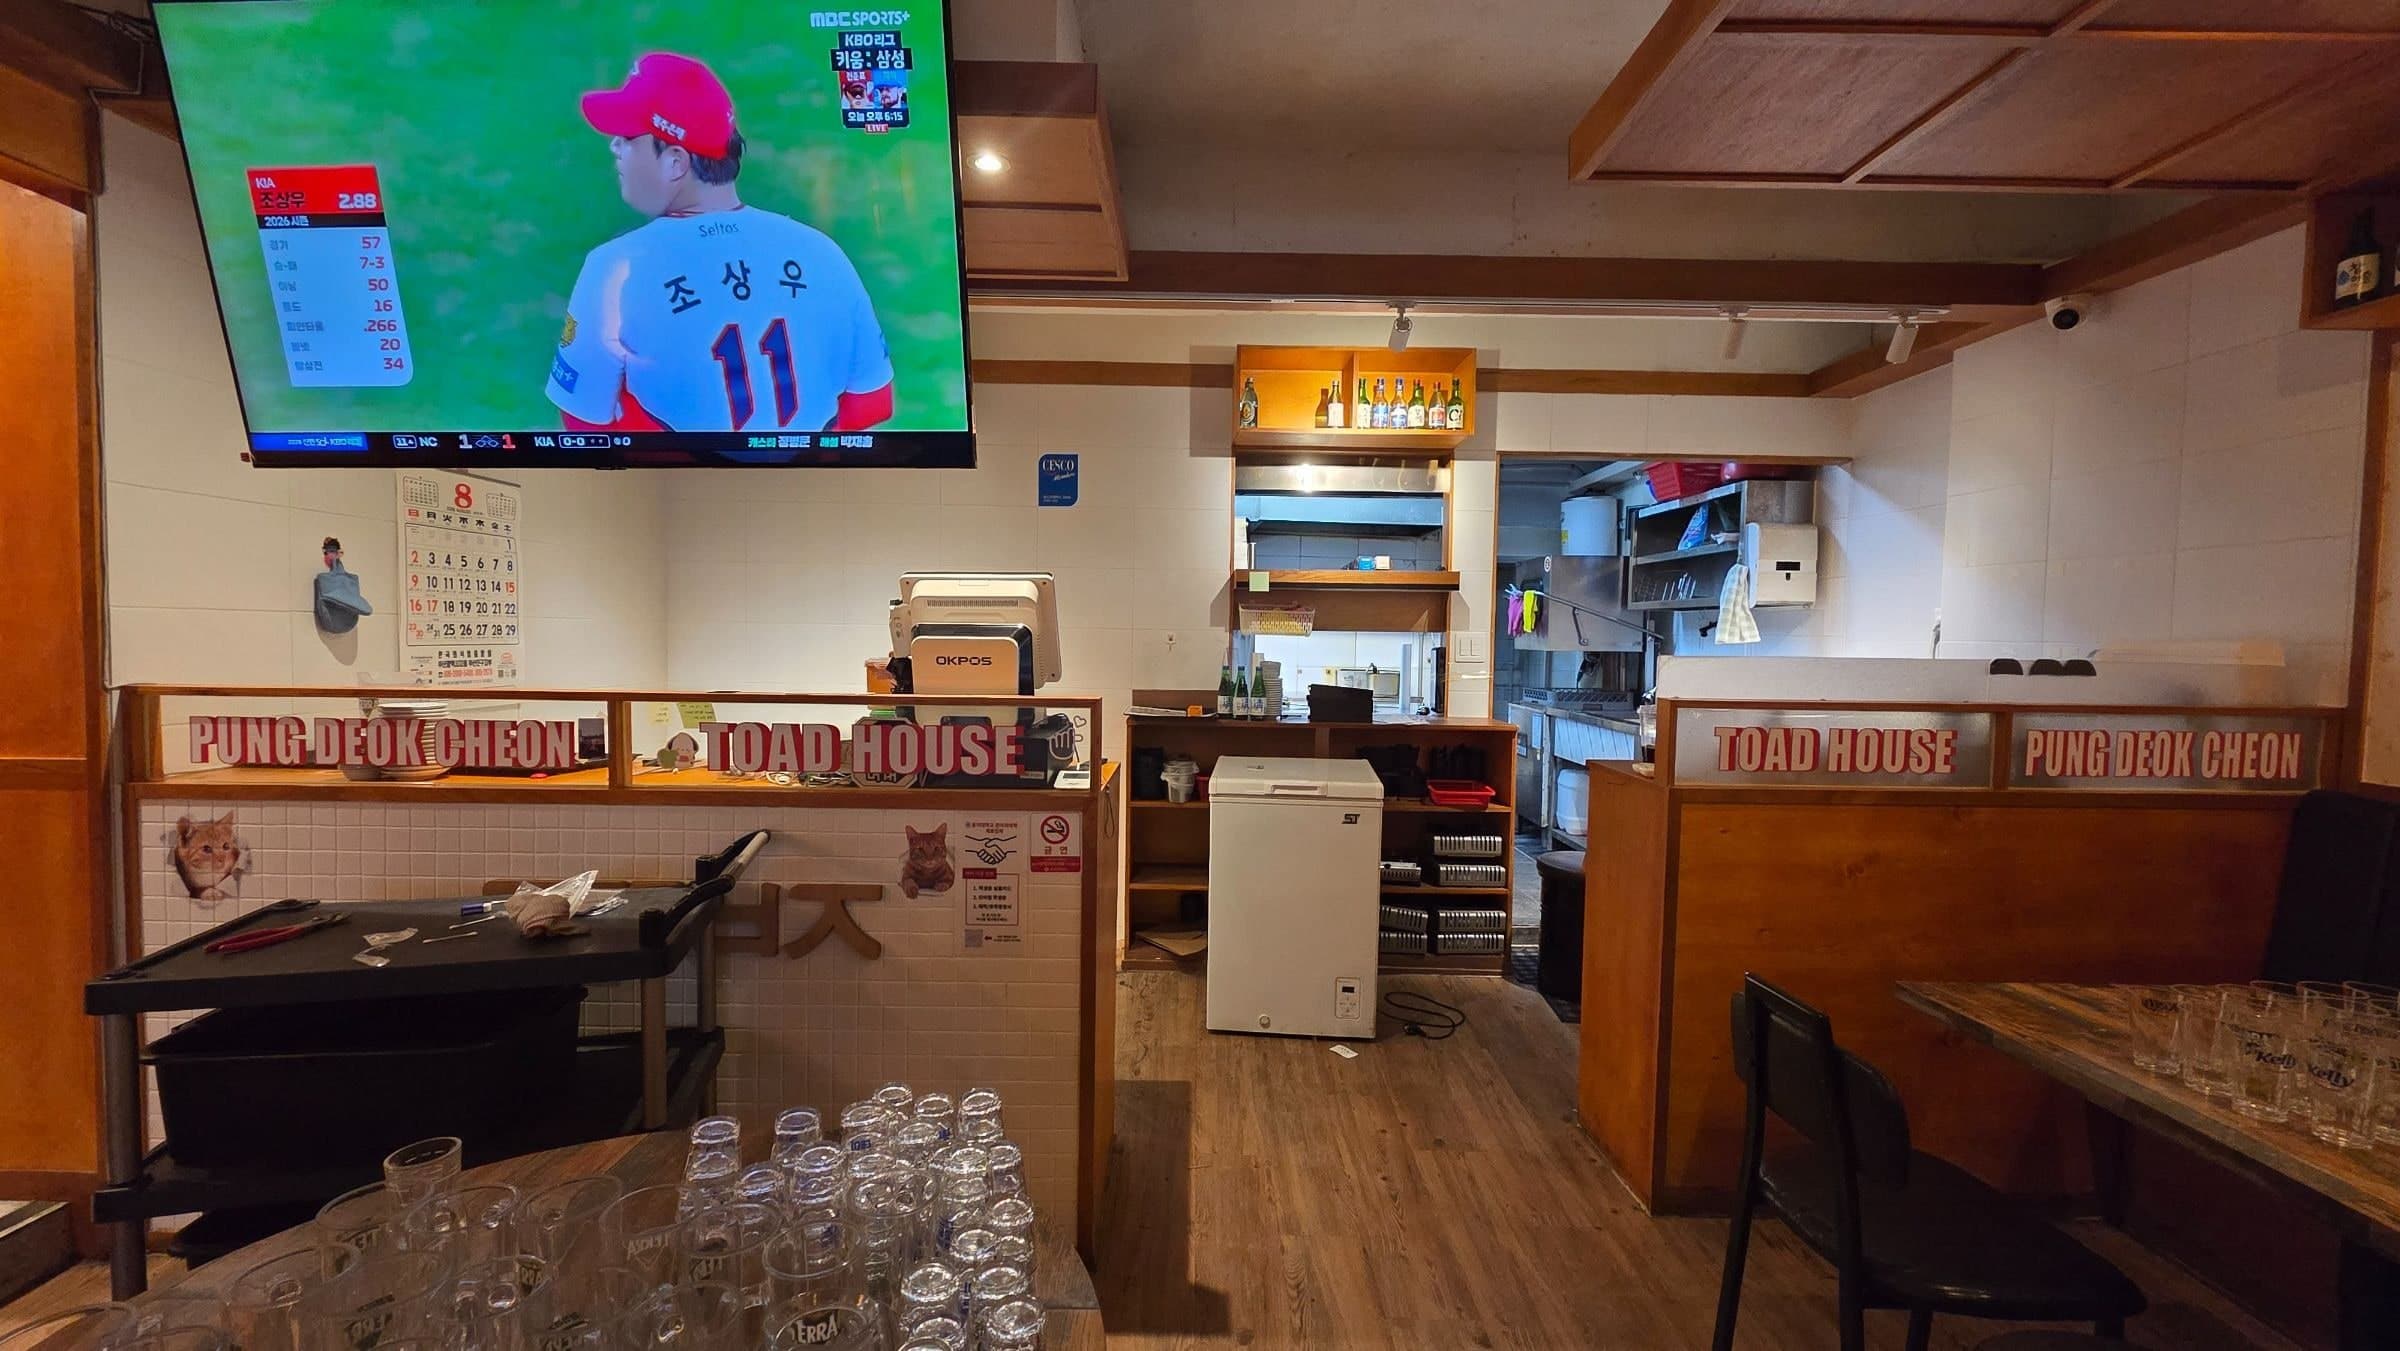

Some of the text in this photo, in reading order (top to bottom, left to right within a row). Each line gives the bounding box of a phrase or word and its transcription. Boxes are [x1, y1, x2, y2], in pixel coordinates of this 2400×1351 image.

[810, 12, 851, 27] MBC
[836, 50, 864, 69] 키움
[877, 50, 905, 69] 삼성
[848, 112, 865, 122] 오늘
[885, 112, 903, 121] 6:15
[867, 124, 887, 132] LIVE
[255, 177, 276, 189] KIA
[261, 191, 377, 209] 조상우 2.88
[264, 216, 290, 226] 2026
[699, 223, 739, 238] Seltos
[362, 236, 381, 249] 57
[359, 256, 385, 269] 7-3
[368, 278, 389, 291] 50
[374, 299, 393, 312] 16
[364, 319, 397, 332] .266
[380, 338, 401, 351] 20
[383, 357, 404, 370] 34
[711, 317, 798, 431] 11
[419, 436, 440, 447] NC
[459, 434, 472, 449] 1
[502, 434, 516, 449] 1
[535, 436, 554, 447] KIA
[563, 436, 585, 446] 0-0
[1042, 460, 1074, 471] CESCO
[454, 483, 472, 508] 8
[411, 551, 418, 563] 2
[429, 552, 435, 564] 3
[445, 554, 451, 566] 4
[461, 556, 468, 567] 5
[478, 557, 484, 569] 6
[411, 575, 515, 593] 9 10 11 12 13 14 15
[410, 600, 515, 614] 16 17 18 19 20 21 22
[443, 624, 455, 635] 25
[460, 624, 472, 635] 26
[476, 624, 487, 635] 27
[492, 625, 502, 635] 28
[505, 625, 515, 635] 29
[935, 656, 992, 666] OKPOS
[189, 716, 575, 768] PUNG DEOK CHEON
[699, 722, 1025, 776] TOAD HOUSE
[1714, 726, 1957, 774] TOAD HOUSE
[2024, 730, 2301, 780] PUNG DEOK CHEON
